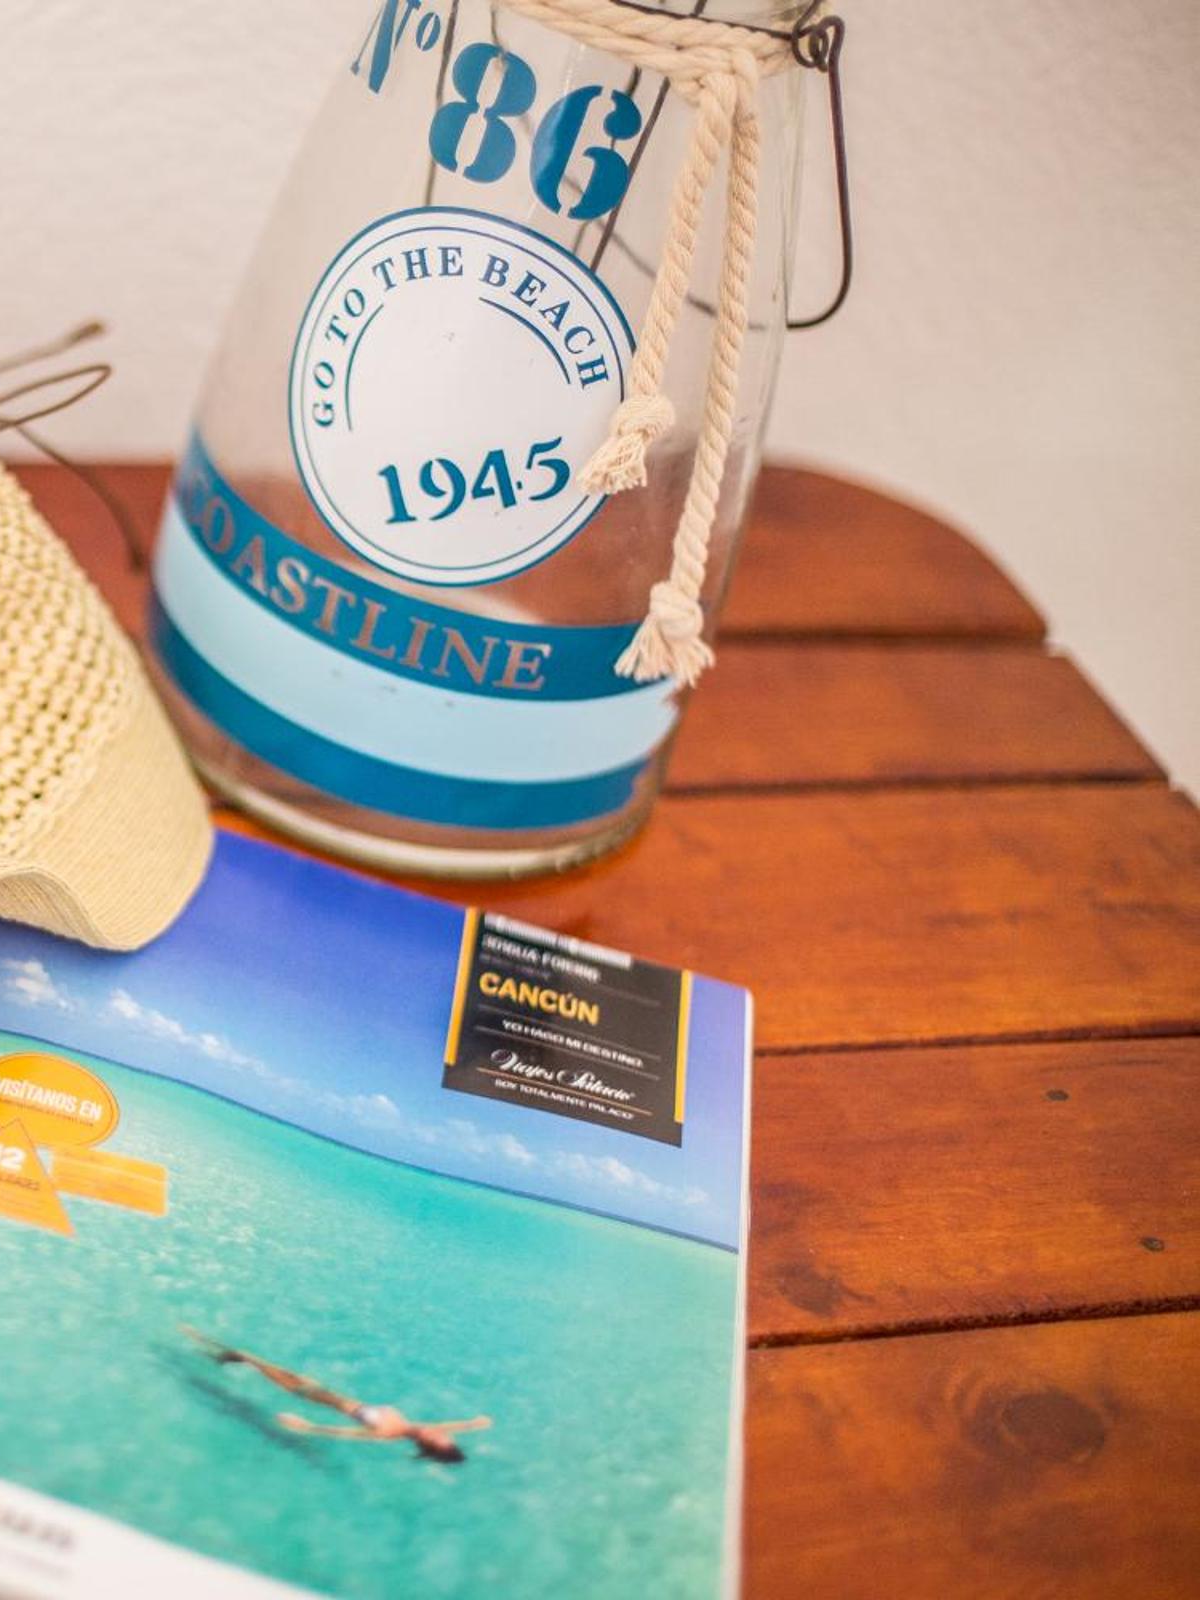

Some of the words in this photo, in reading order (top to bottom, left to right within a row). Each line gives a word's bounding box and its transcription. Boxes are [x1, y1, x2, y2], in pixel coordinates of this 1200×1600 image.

[428, 42, 642, 220] 86
[311, 360, 336, 428] GO
[324, 288, 367, 346] TO
[372, 245, 464, 292] THE
[478, 253, 609, 390] BEACH
[377, 436, 572, 525] 1945
[478, 972, 600, 1026] CANCÚN
[80, 1100, 102, 1121] EN
